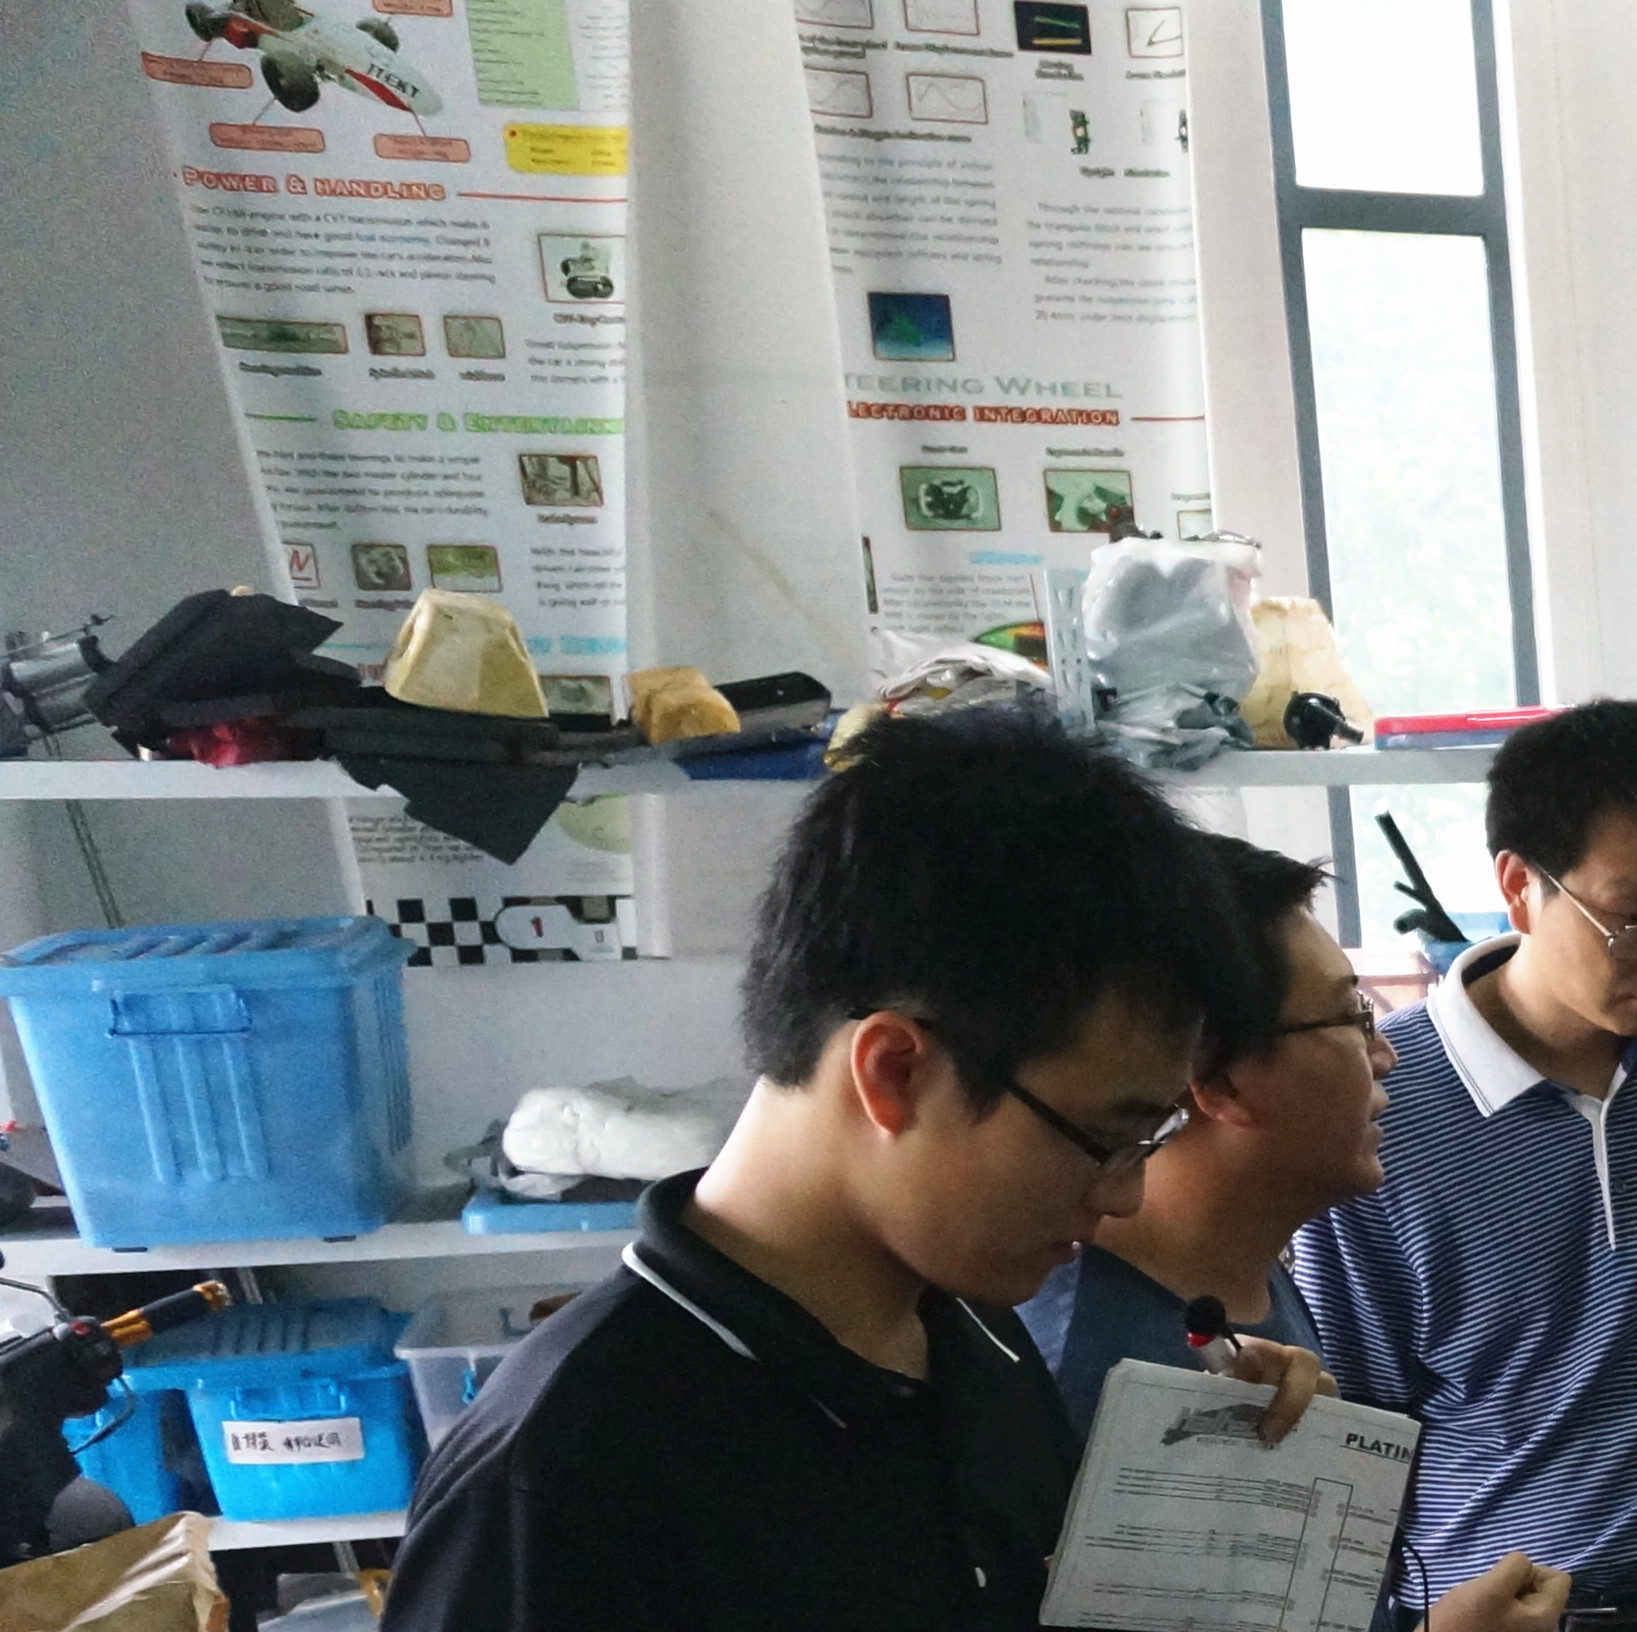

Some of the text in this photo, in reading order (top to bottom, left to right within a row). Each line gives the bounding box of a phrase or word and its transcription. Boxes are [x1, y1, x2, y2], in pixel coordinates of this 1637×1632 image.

[181, 165, 446, 201] POWER & HANDLING
[973, 405, 1120, 426] INTEGRATION
